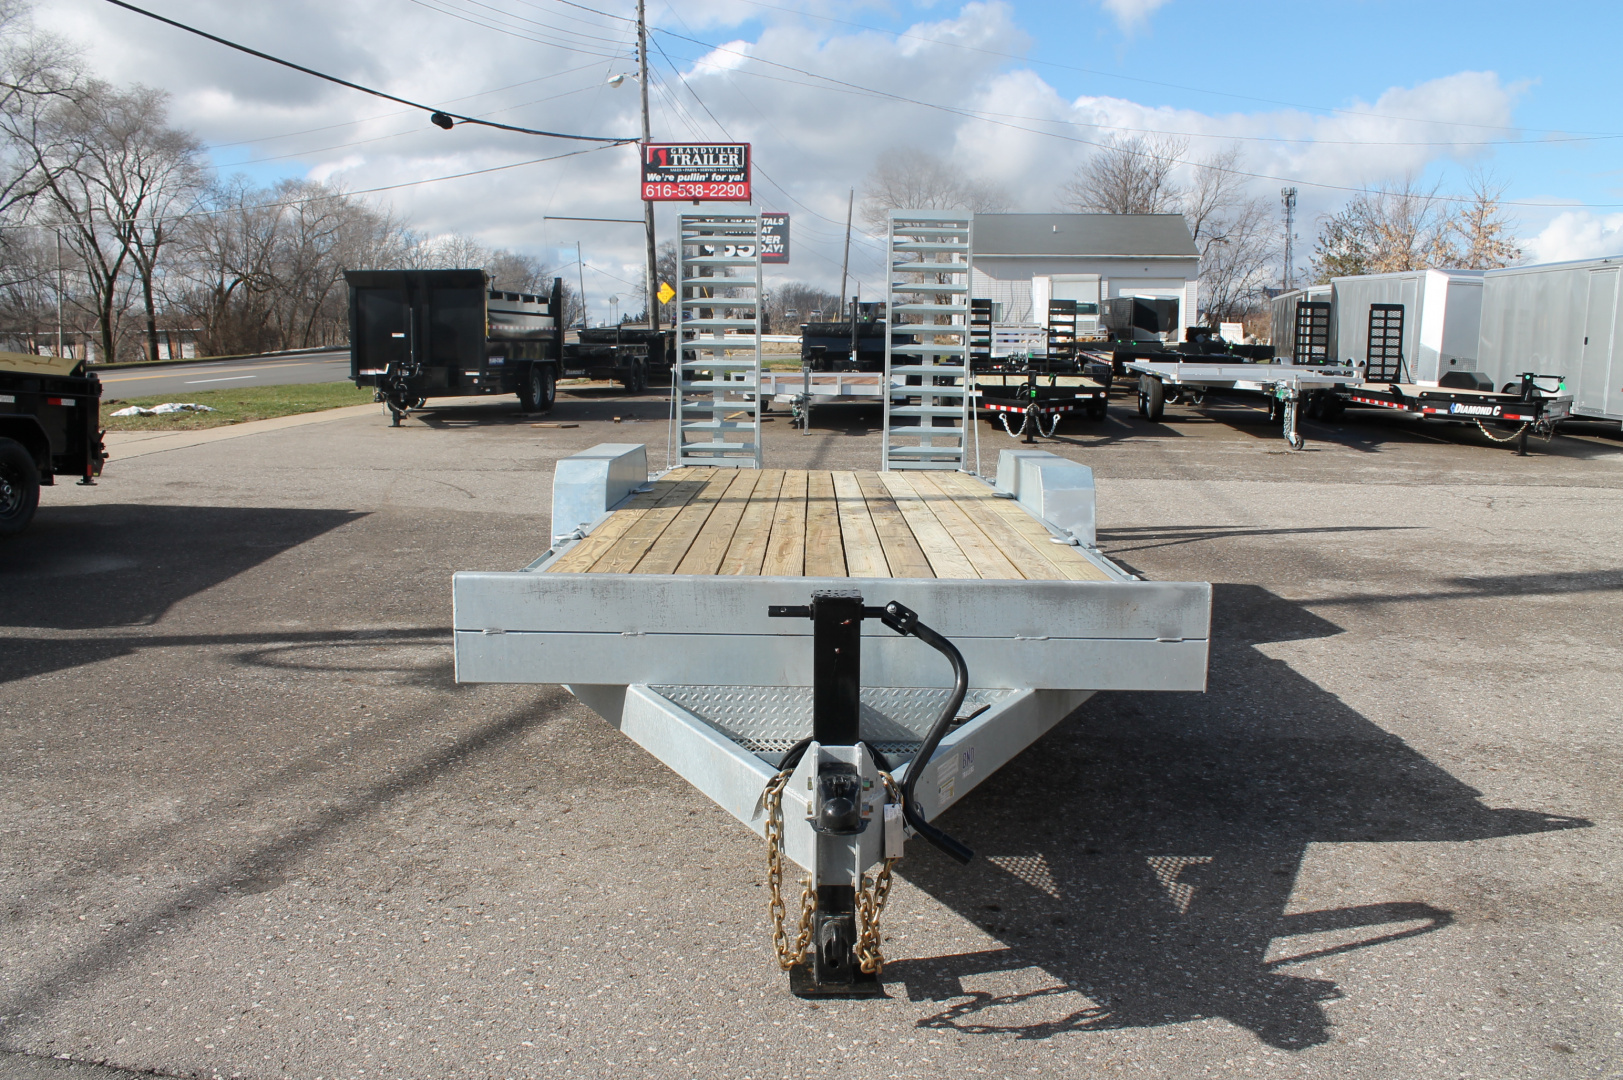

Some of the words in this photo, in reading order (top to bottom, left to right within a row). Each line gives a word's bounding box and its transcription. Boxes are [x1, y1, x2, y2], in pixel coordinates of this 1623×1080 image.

[670, 153, 739, 166] TRAILER
[646, 173, 675, 182] We're
[677, 173, 709, 183] pullin'
[711, 173, 727, 182] for
[728, 173, 745, 183] ya!
[645, 184, 745, 197] 616-538-2290
[1454, 403, 1493, 415] DIAMOND
[1493, 405, 1501, 416] C
